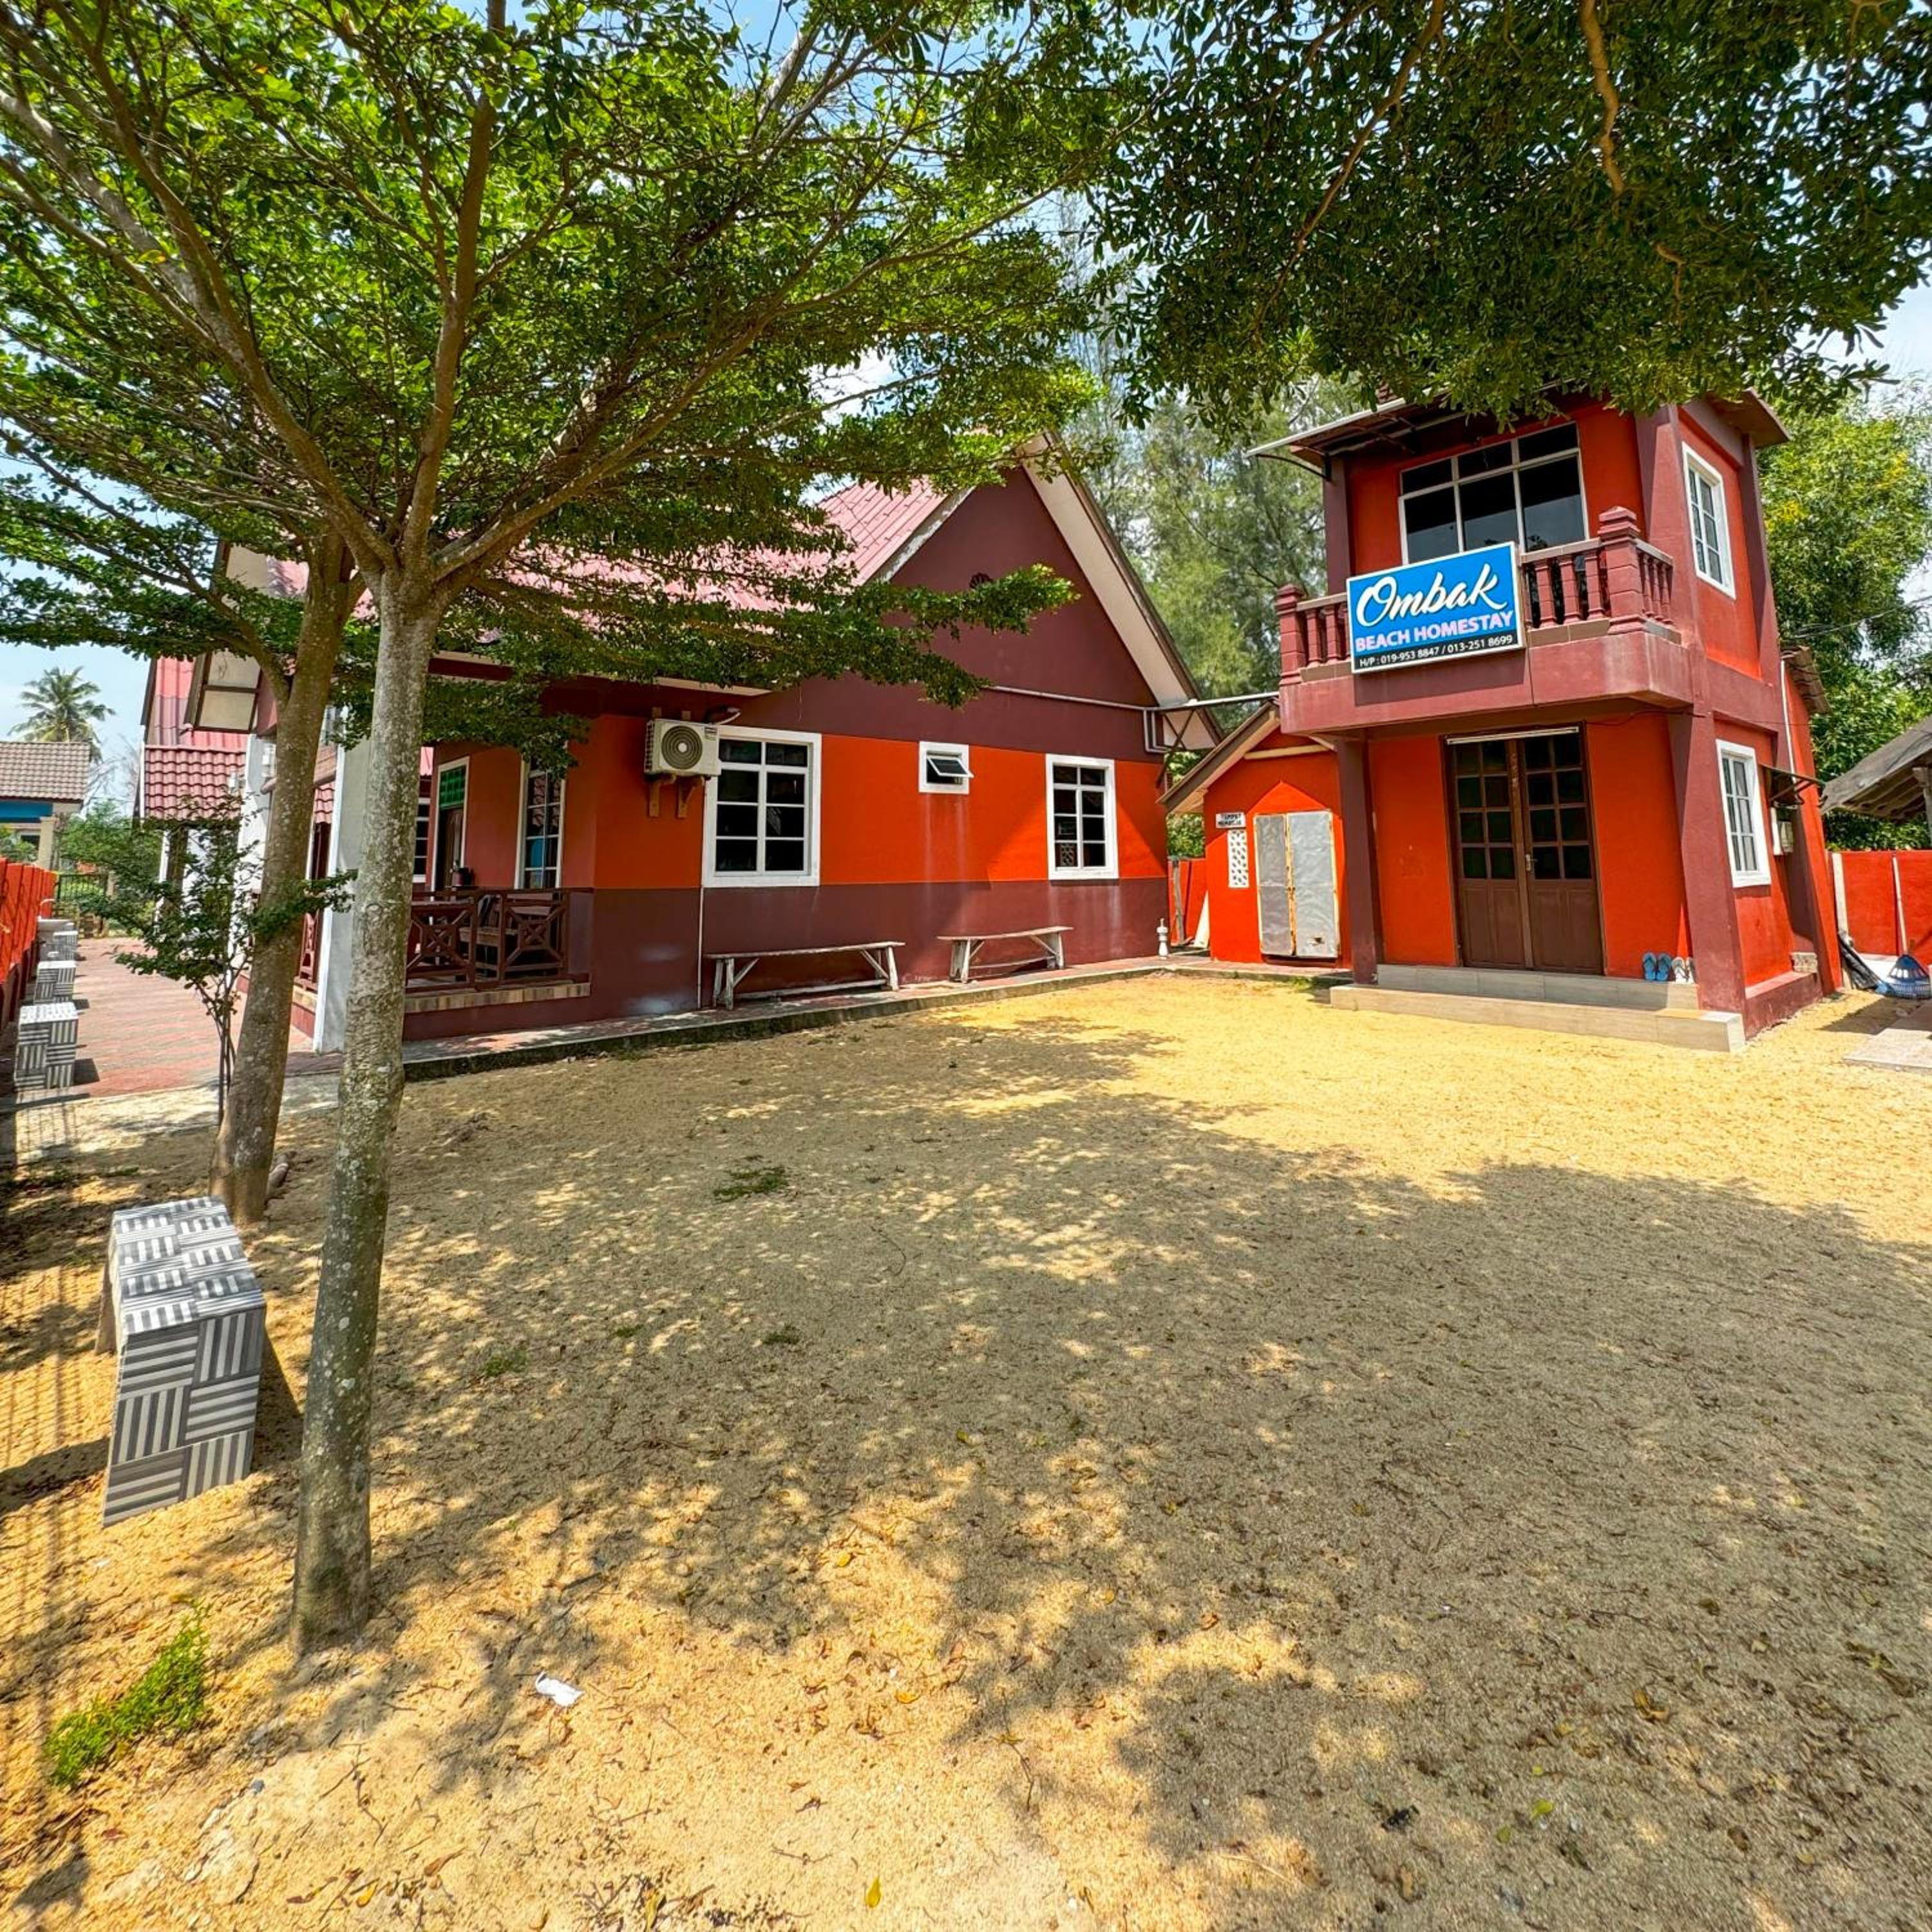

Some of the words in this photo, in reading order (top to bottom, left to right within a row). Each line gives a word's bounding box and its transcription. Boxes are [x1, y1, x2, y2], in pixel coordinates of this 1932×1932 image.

[1356, 564, 1508, 627] Ombak
[1355, 629, 1411, 652] BEACH
[1414, 611, 1513, 642] HOMESTAY
[1380, 650, 1416, 664] 019-953
[1417, 646, 1440, 658] 8847
[1447, 639, 1485, 653] 013-251
[1488, 634, 1513, 647] 8699
